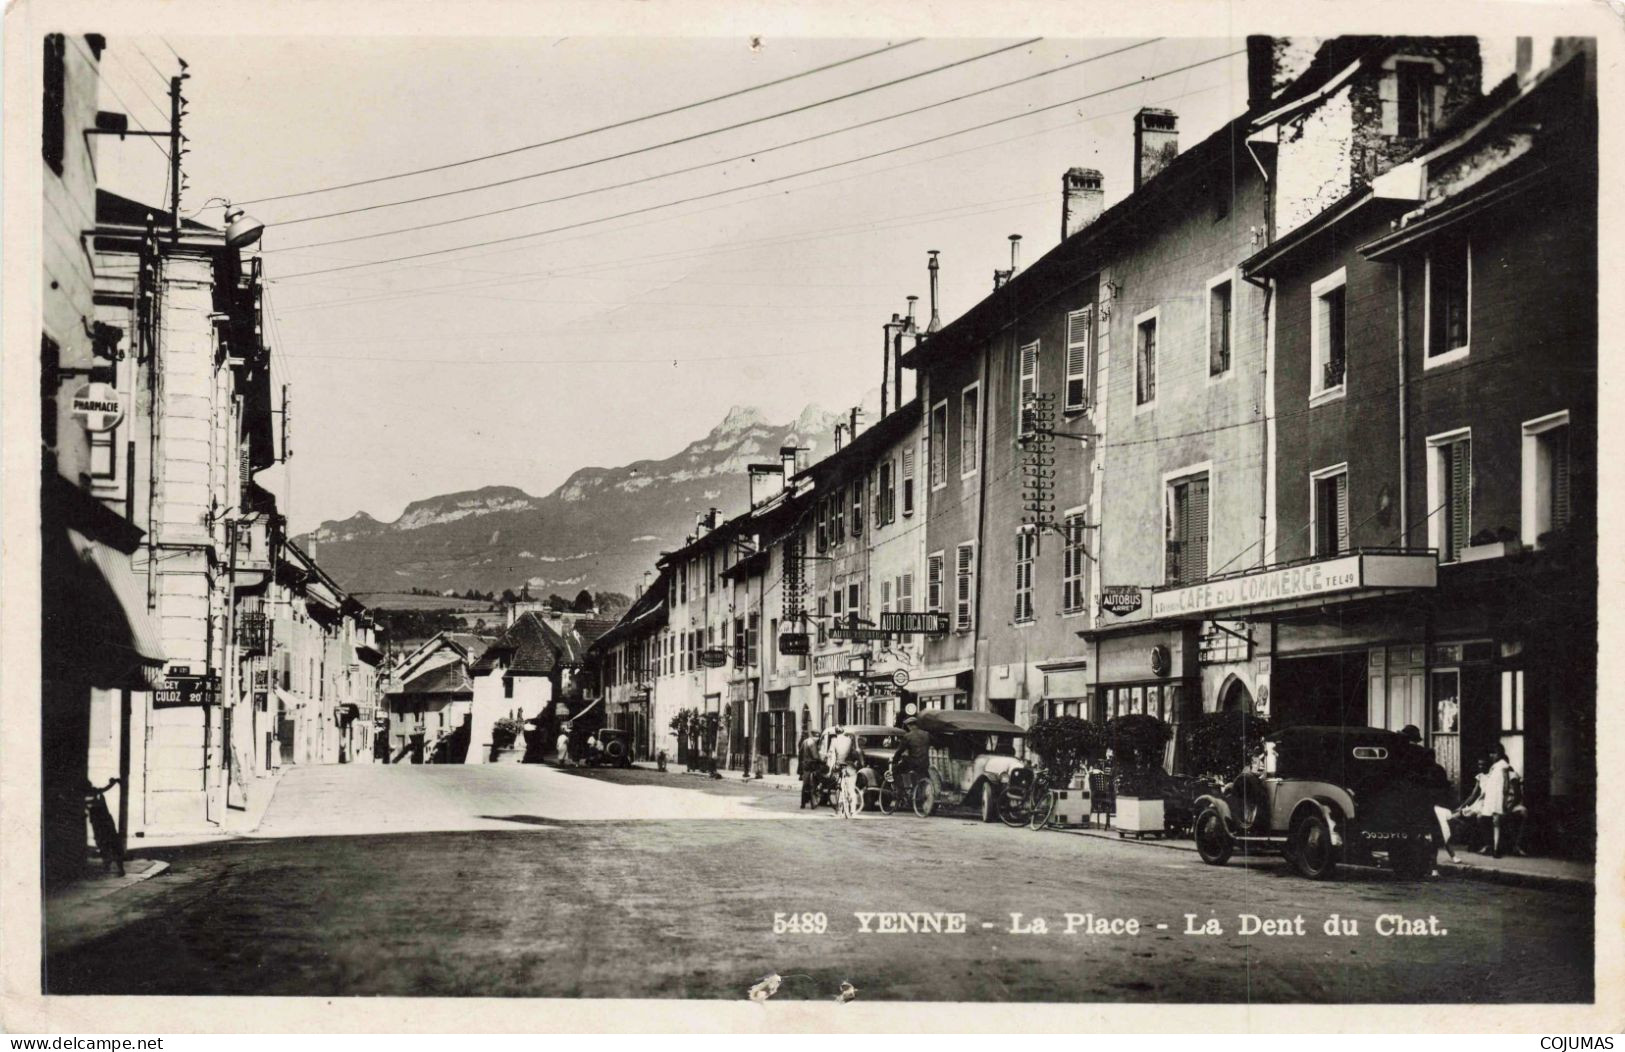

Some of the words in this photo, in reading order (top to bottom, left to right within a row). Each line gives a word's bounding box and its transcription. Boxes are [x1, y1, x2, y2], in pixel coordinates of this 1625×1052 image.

[73, 400, 119, 412] PHARMACIE
[1217, 589, 1235, 604] DU
[1239, 565, 1322, 601] COMMERCE
[1103, 594, 1141, 605] AUTOBUS
[881, 615, 901, 631] AUTO
[903, 615, 938, 631] LOCATION
[155, 691, 182, 702] CULOZ
